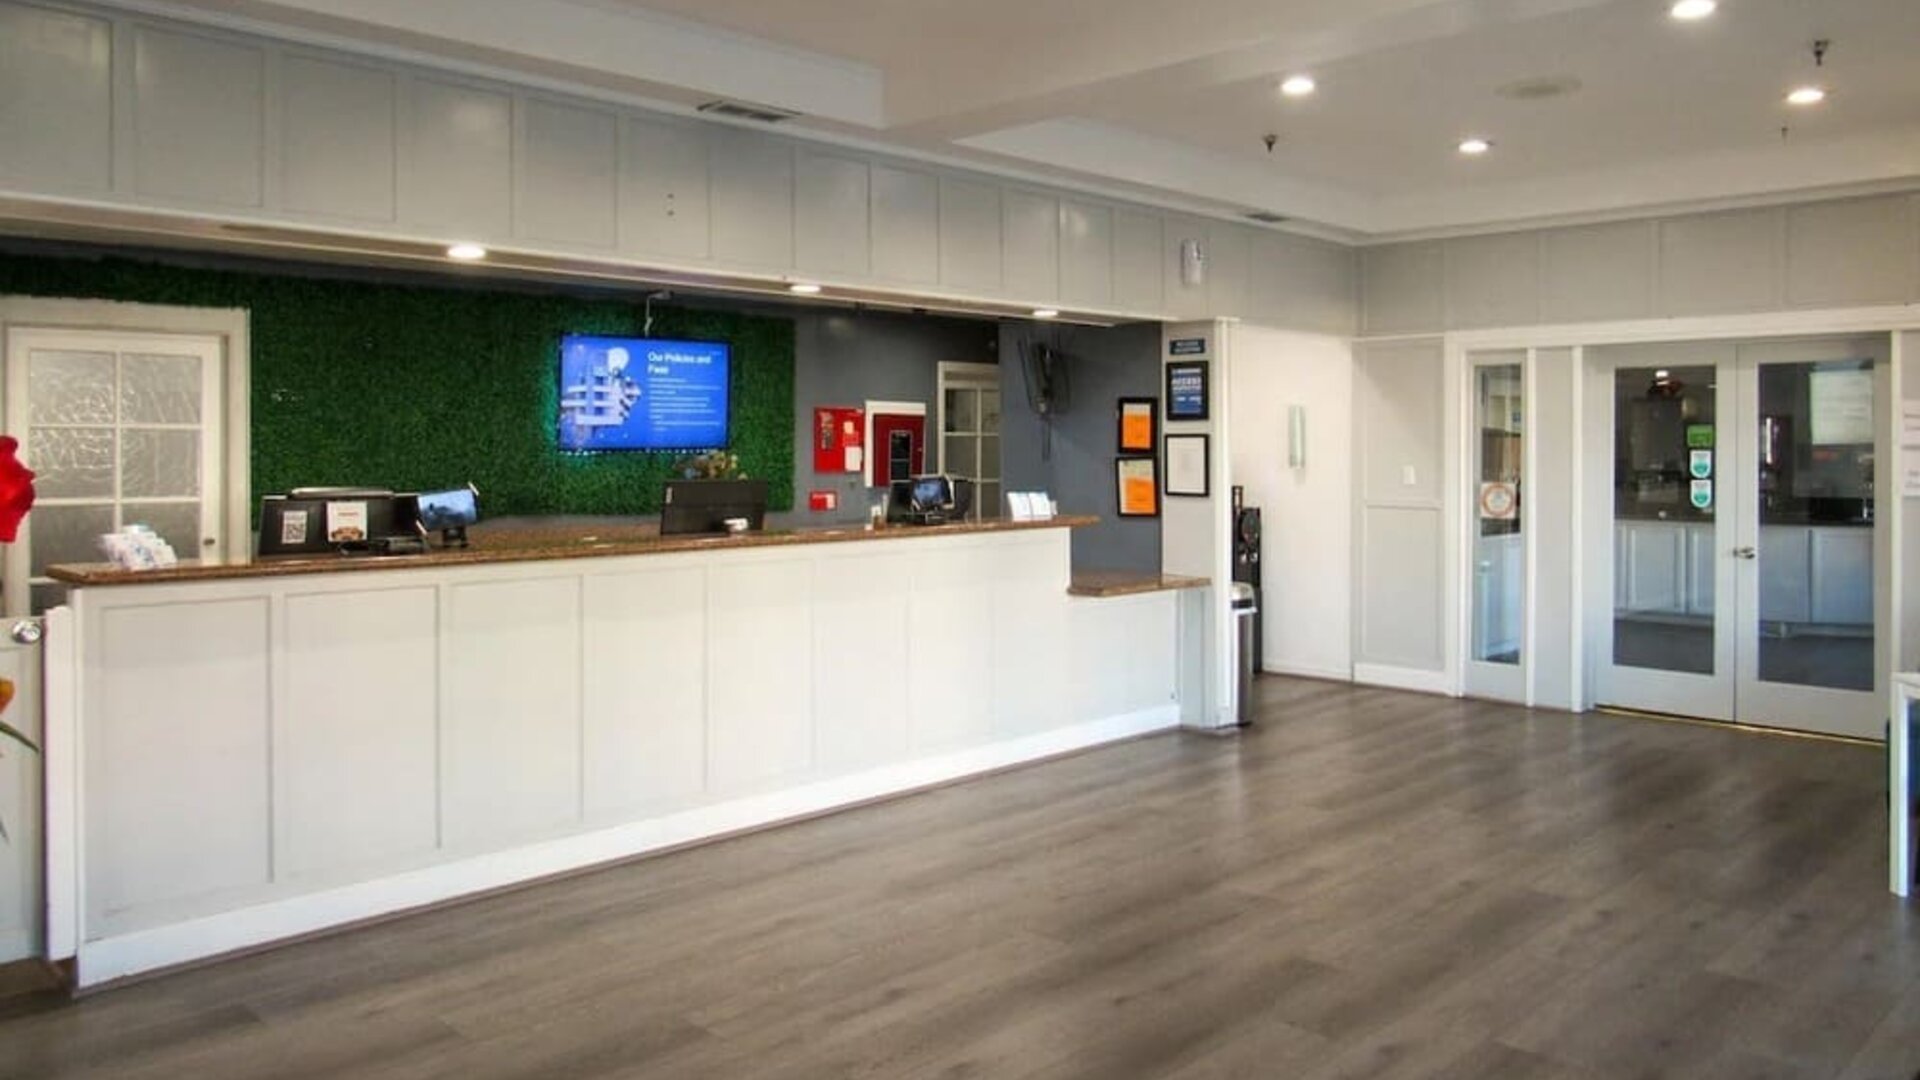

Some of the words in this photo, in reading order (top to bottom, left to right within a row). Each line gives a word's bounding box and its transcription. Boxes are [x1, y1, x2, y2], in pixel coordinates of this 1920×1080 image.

[648, 351, 663, 362] Our
[665, 352, 694, 364] Policies
[697, 354, 712, 364] and
